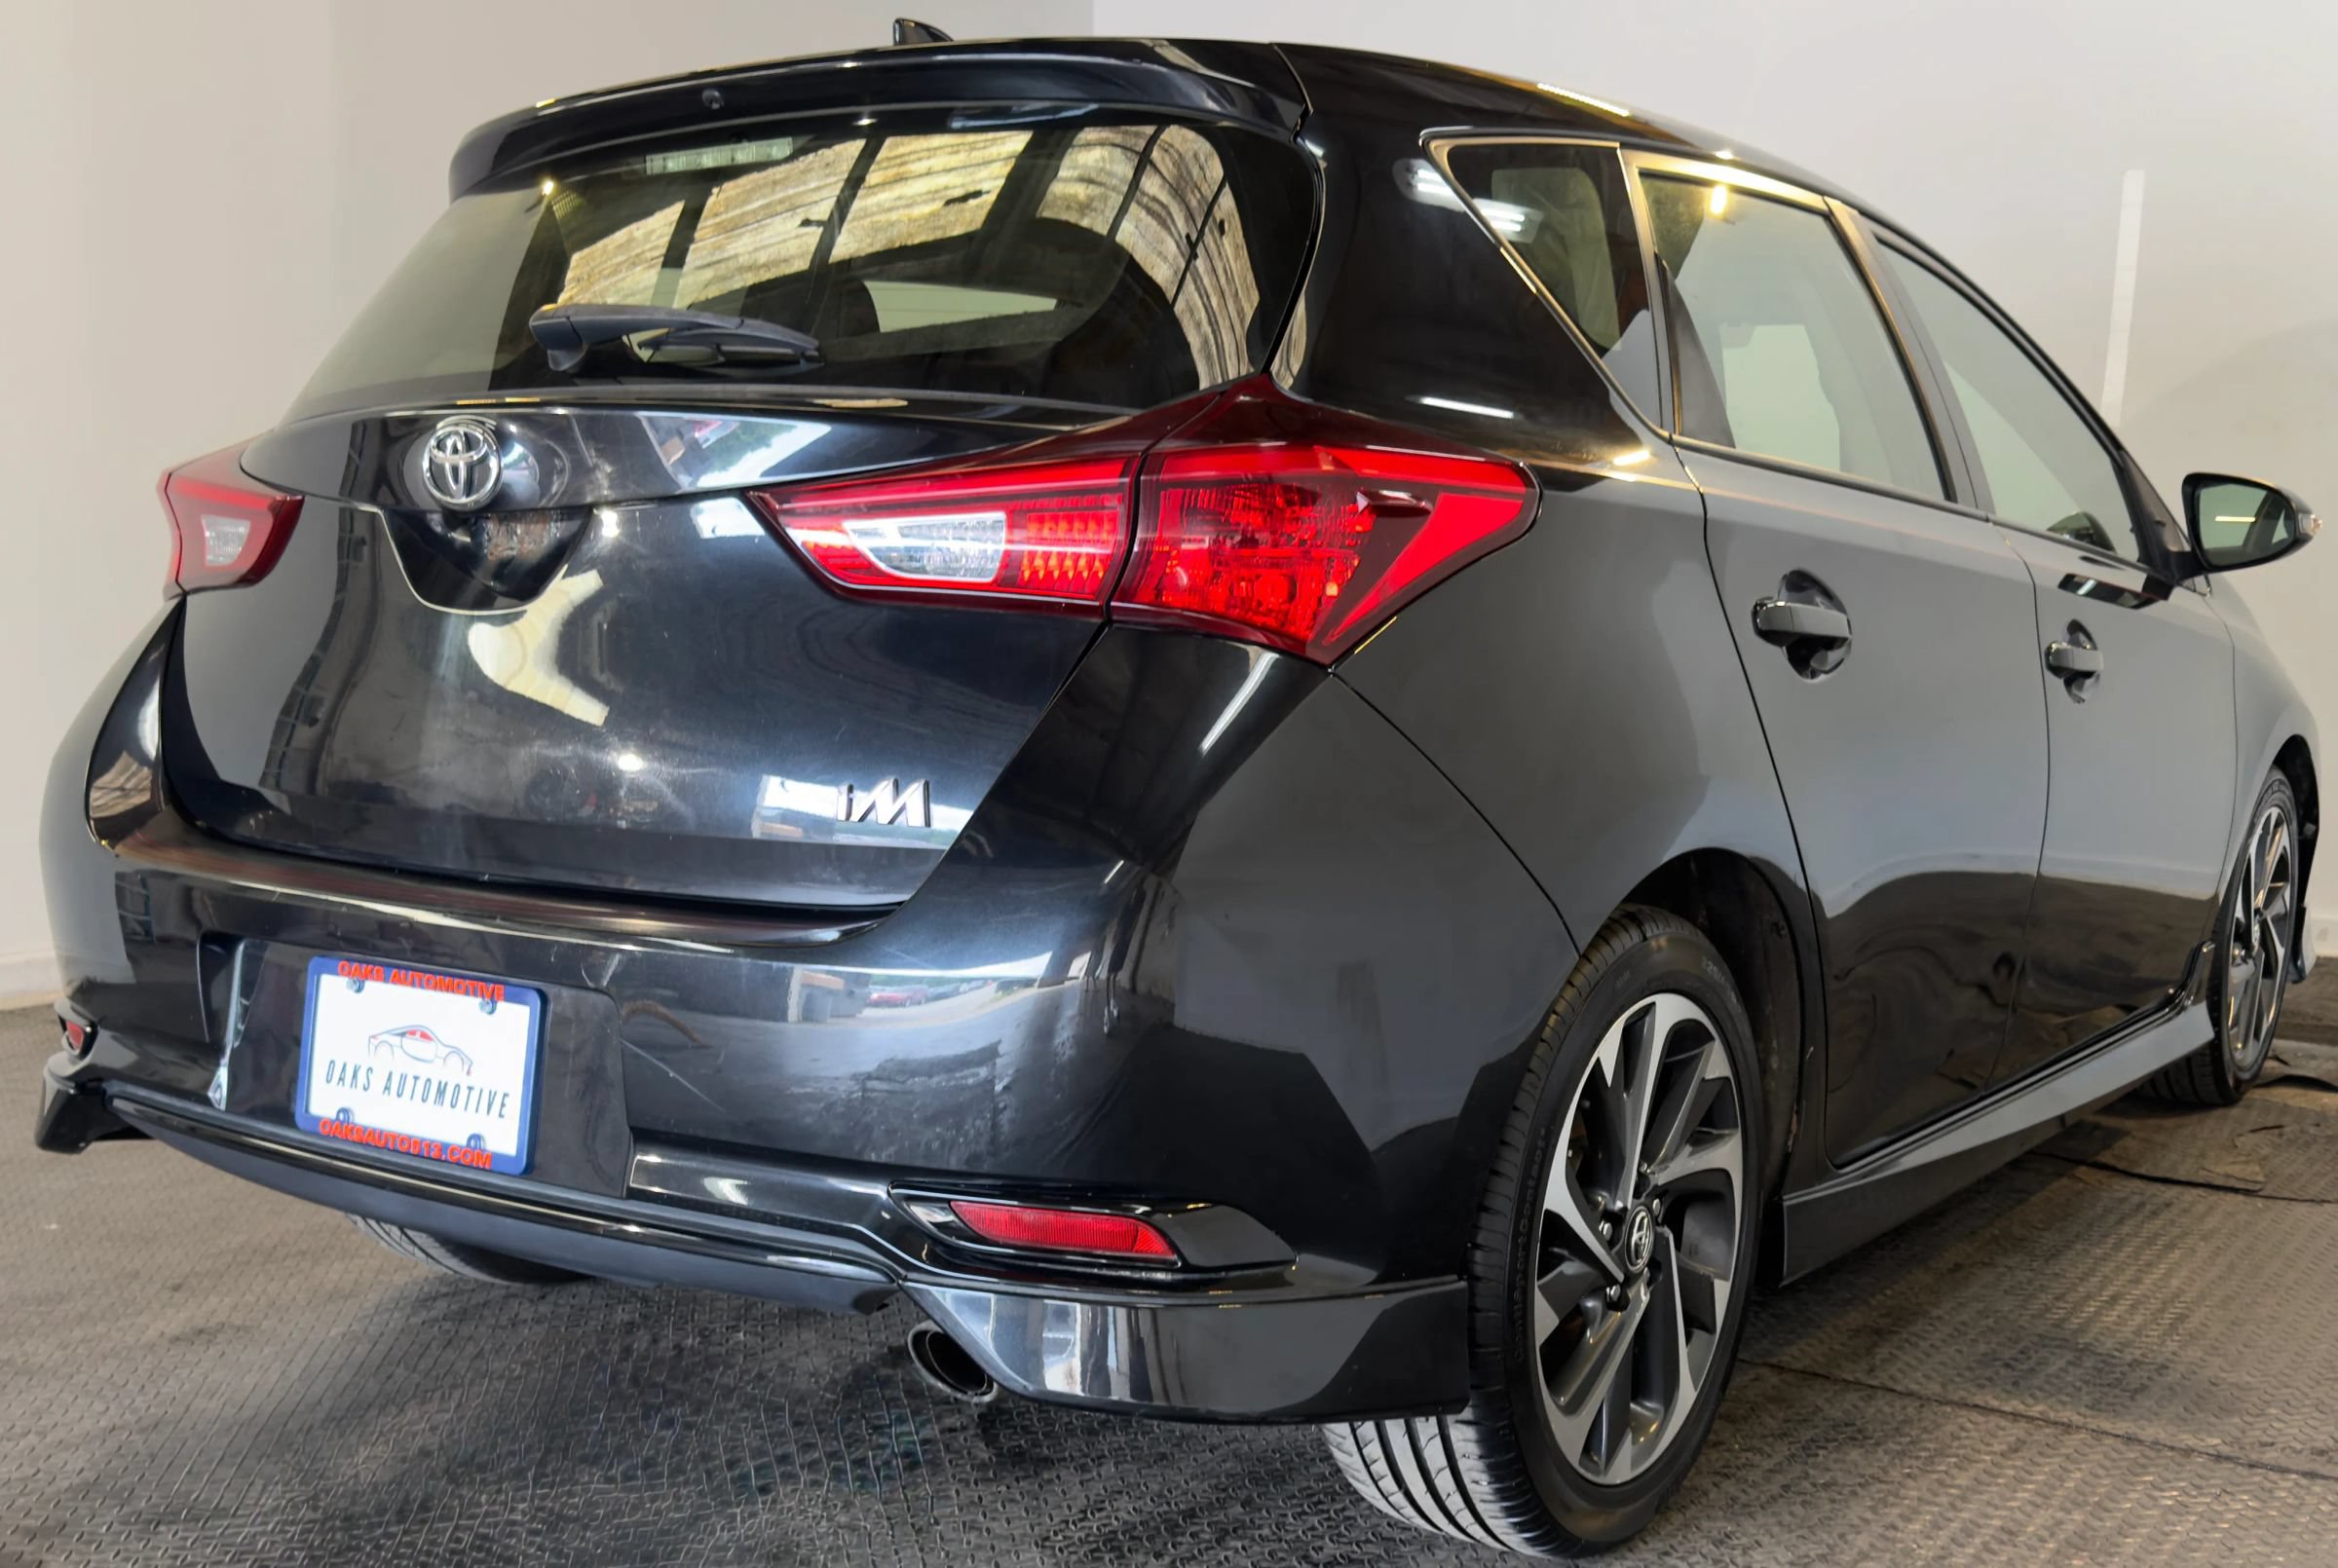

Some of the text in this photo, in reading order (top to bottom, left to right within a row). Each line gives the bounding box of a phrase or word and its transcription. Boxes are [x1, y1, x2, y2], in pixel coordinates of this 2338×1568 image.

[338, 960, 505, 1001] OAKS AUTOMOTIVE
[325, 1060, 509, 1119] OAKS AUTOMOTIVE
